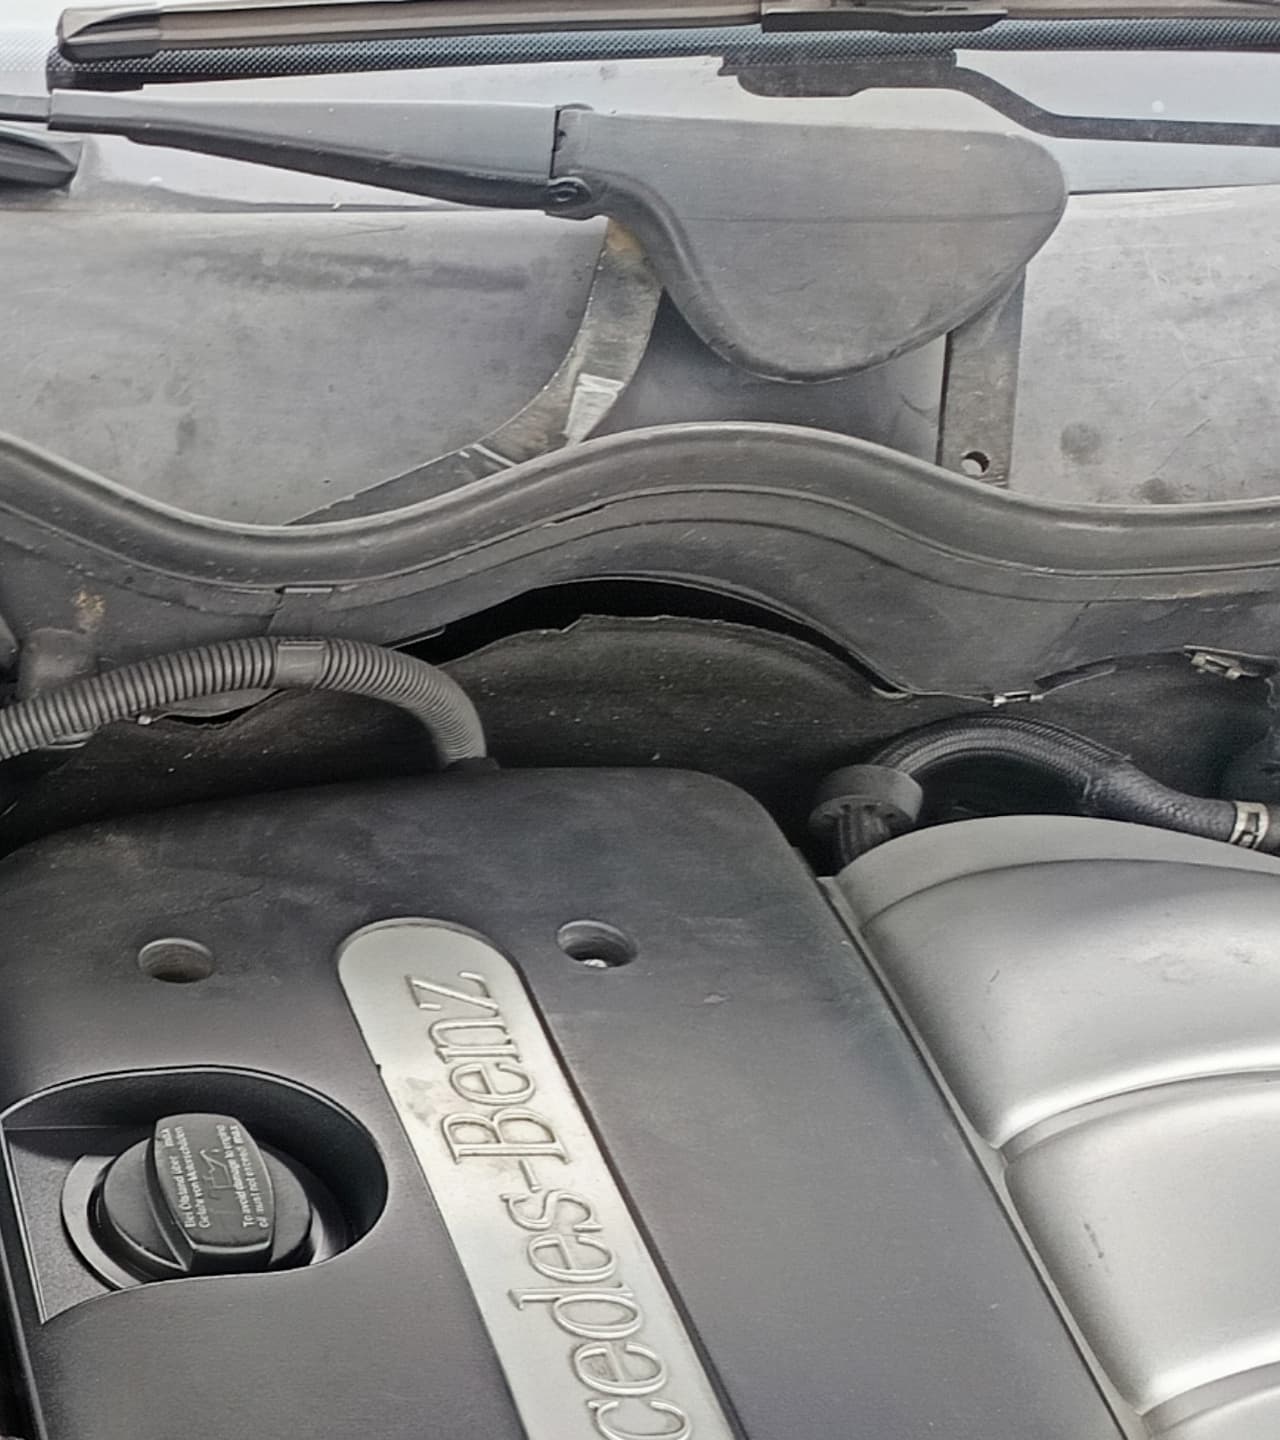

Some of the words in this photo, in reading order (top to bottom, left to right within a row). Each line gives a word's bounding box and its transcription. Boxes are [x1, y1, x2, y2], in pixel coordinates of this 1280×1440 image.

[245, 1177, 260, 1191] not
[235, 1190, 251, 1214] avoid
[242, 1214, 256, 1228] To
